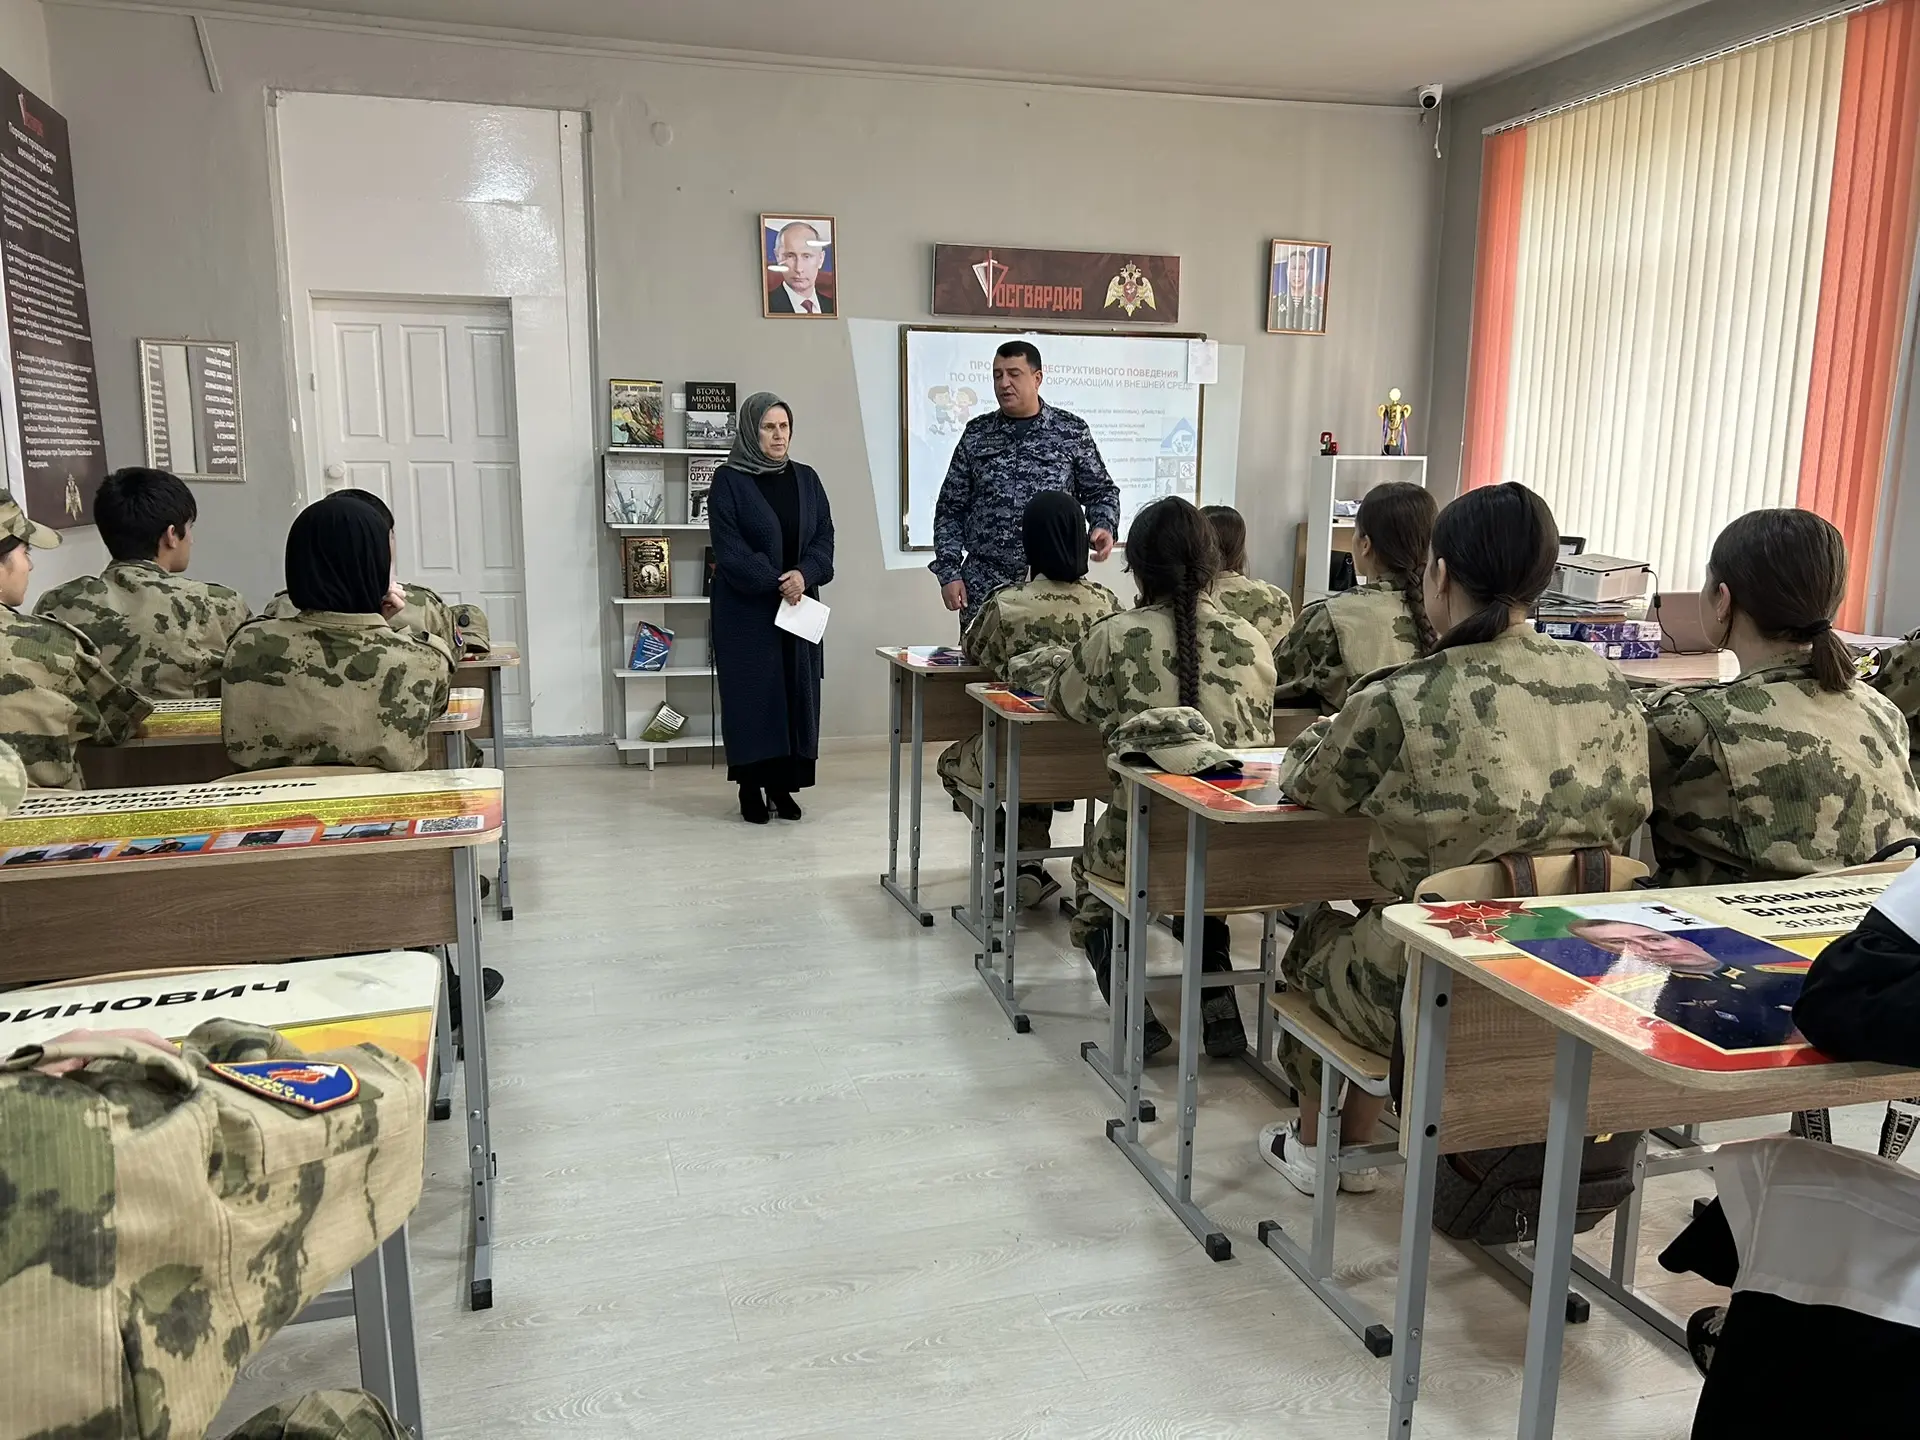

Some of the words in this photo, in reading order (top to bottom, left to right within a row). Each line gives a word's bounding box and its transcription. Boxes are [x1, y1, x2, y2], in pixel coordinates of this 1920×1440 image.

[1043, 364, 1125, 377] ДЕСТРУКТИВНОГО
[1127, 368, 1178, 379] ПОВЕДЕНИЯ
[950, 372, 966, 382] ПО
[1046, 376, 1114, 388] ОКРУЖАЮЩИМ
[1116, 380, 1123, 388] И
[1124, 379, 1165, 390] ВНЕШНЕЙ
[691, 395, 731, 403] МИРОВАЯ
[690, 473, 714, 481] ОРУЖ
[22, 790, 178, 804] агомедов
[188, 782, 318, 793] Шамиль
[1743, 901, 1874, 917] Владим
